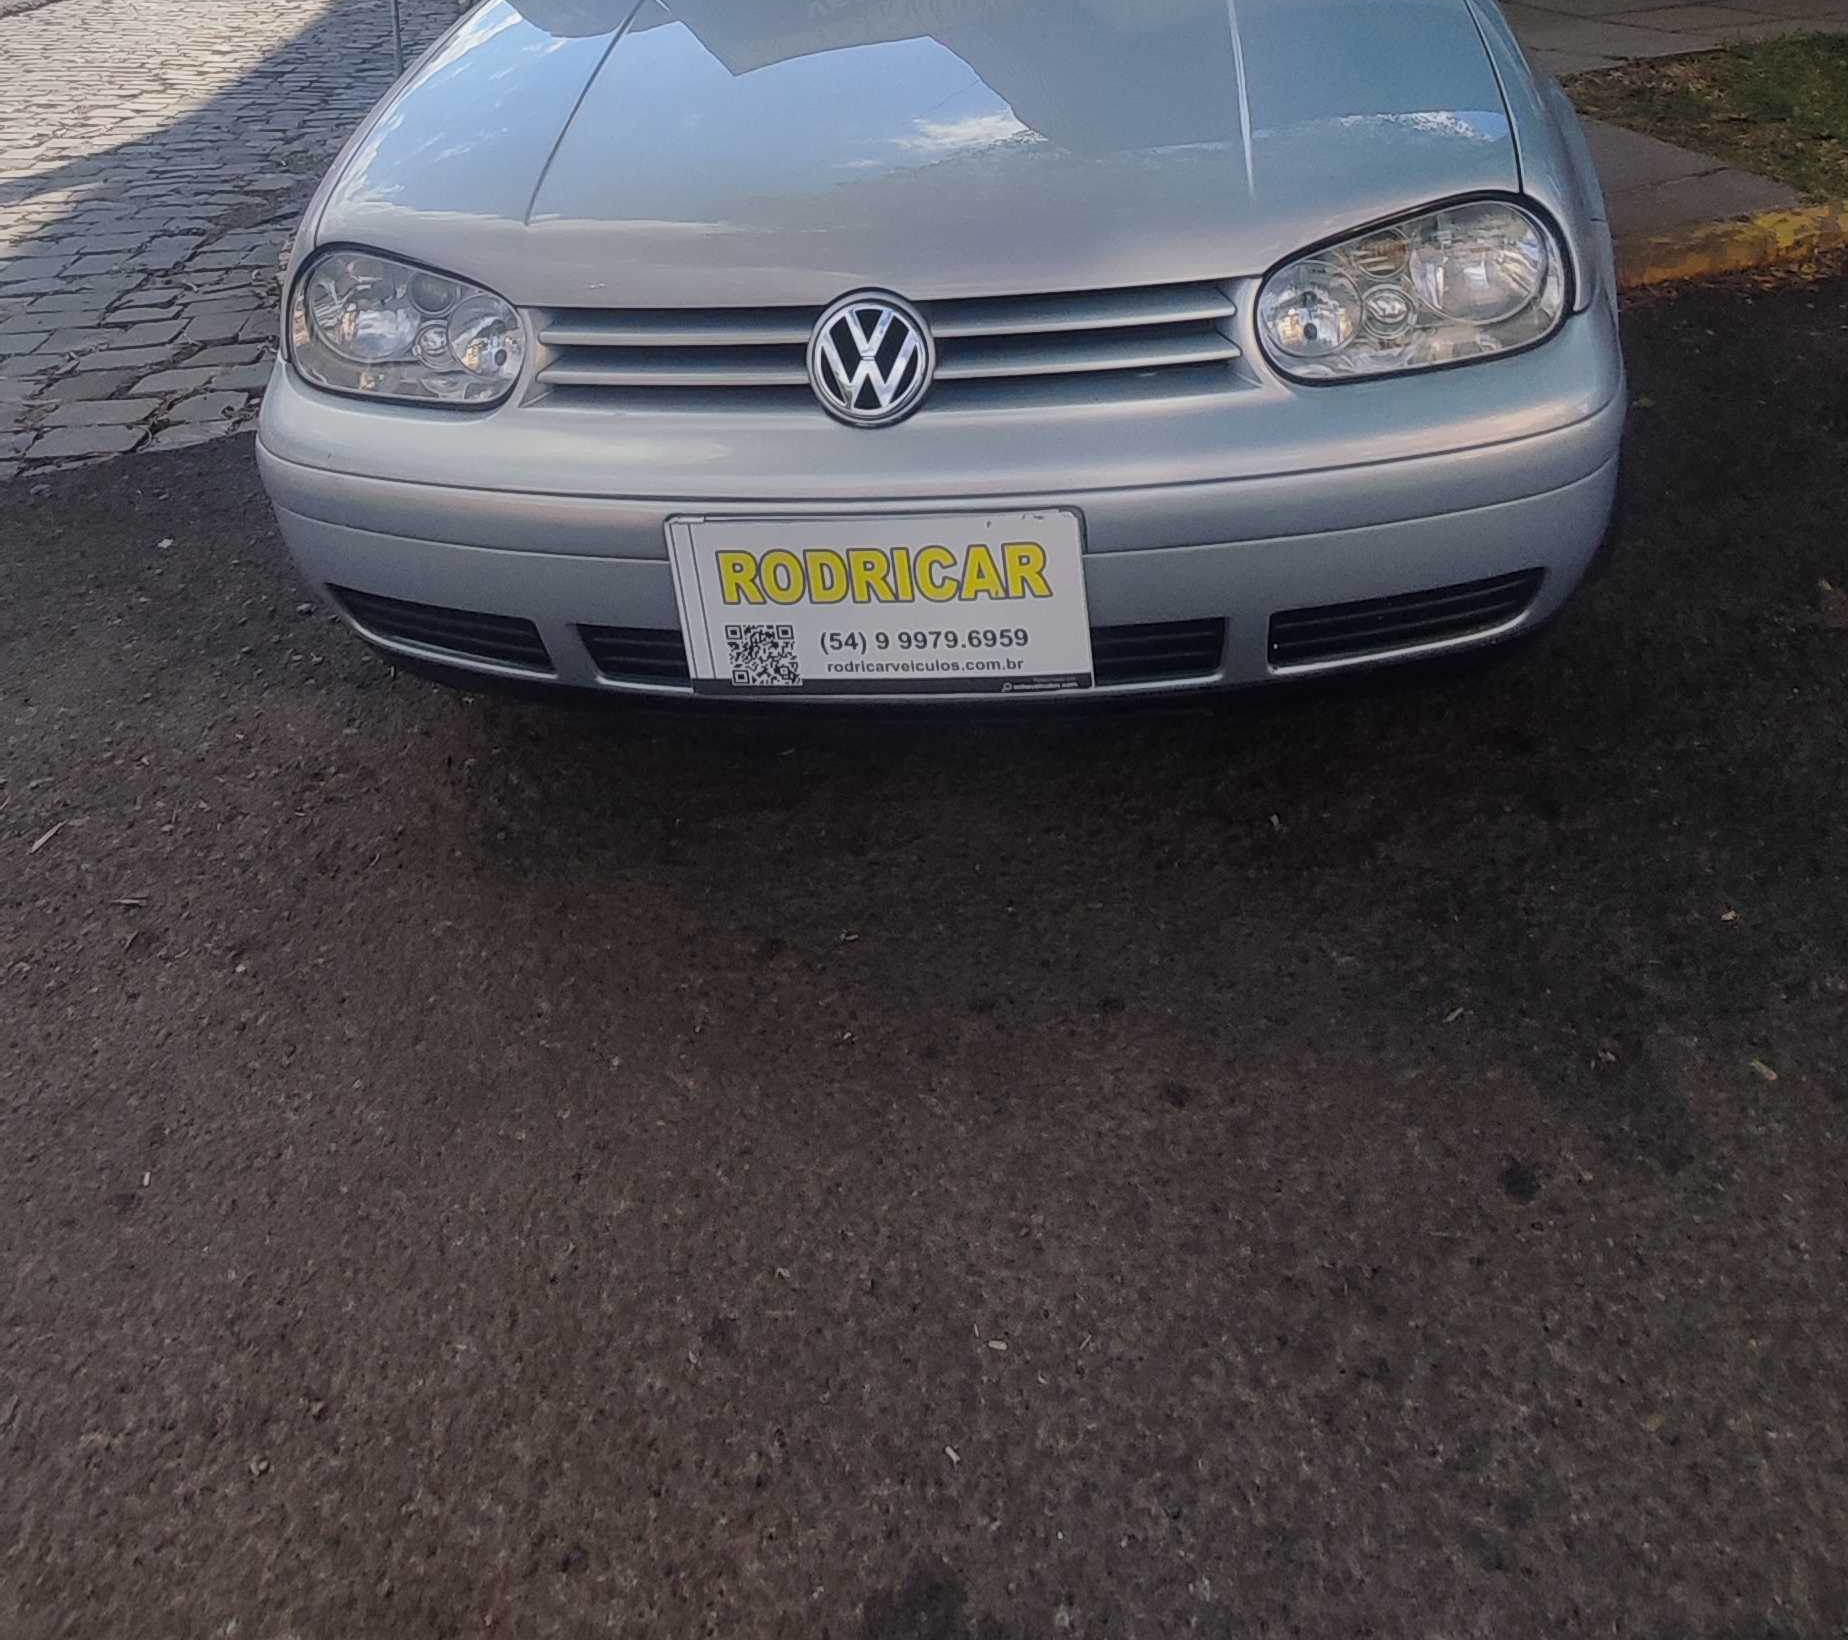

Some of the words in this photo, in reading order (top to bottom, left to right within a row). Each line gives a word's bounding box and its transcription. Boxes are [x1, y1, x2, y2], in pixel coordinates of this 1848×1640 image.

[812, 298, 928, 421] VW
[715, 541, 1053, 605] RODRICAR
[820, 631, 867, 655] (54)
[875, 631, 890, 650] 9
[898, 628, 1029, 649] 9979.6959
[827, 657, 1025, 673] rodricarveiculos.com.br
